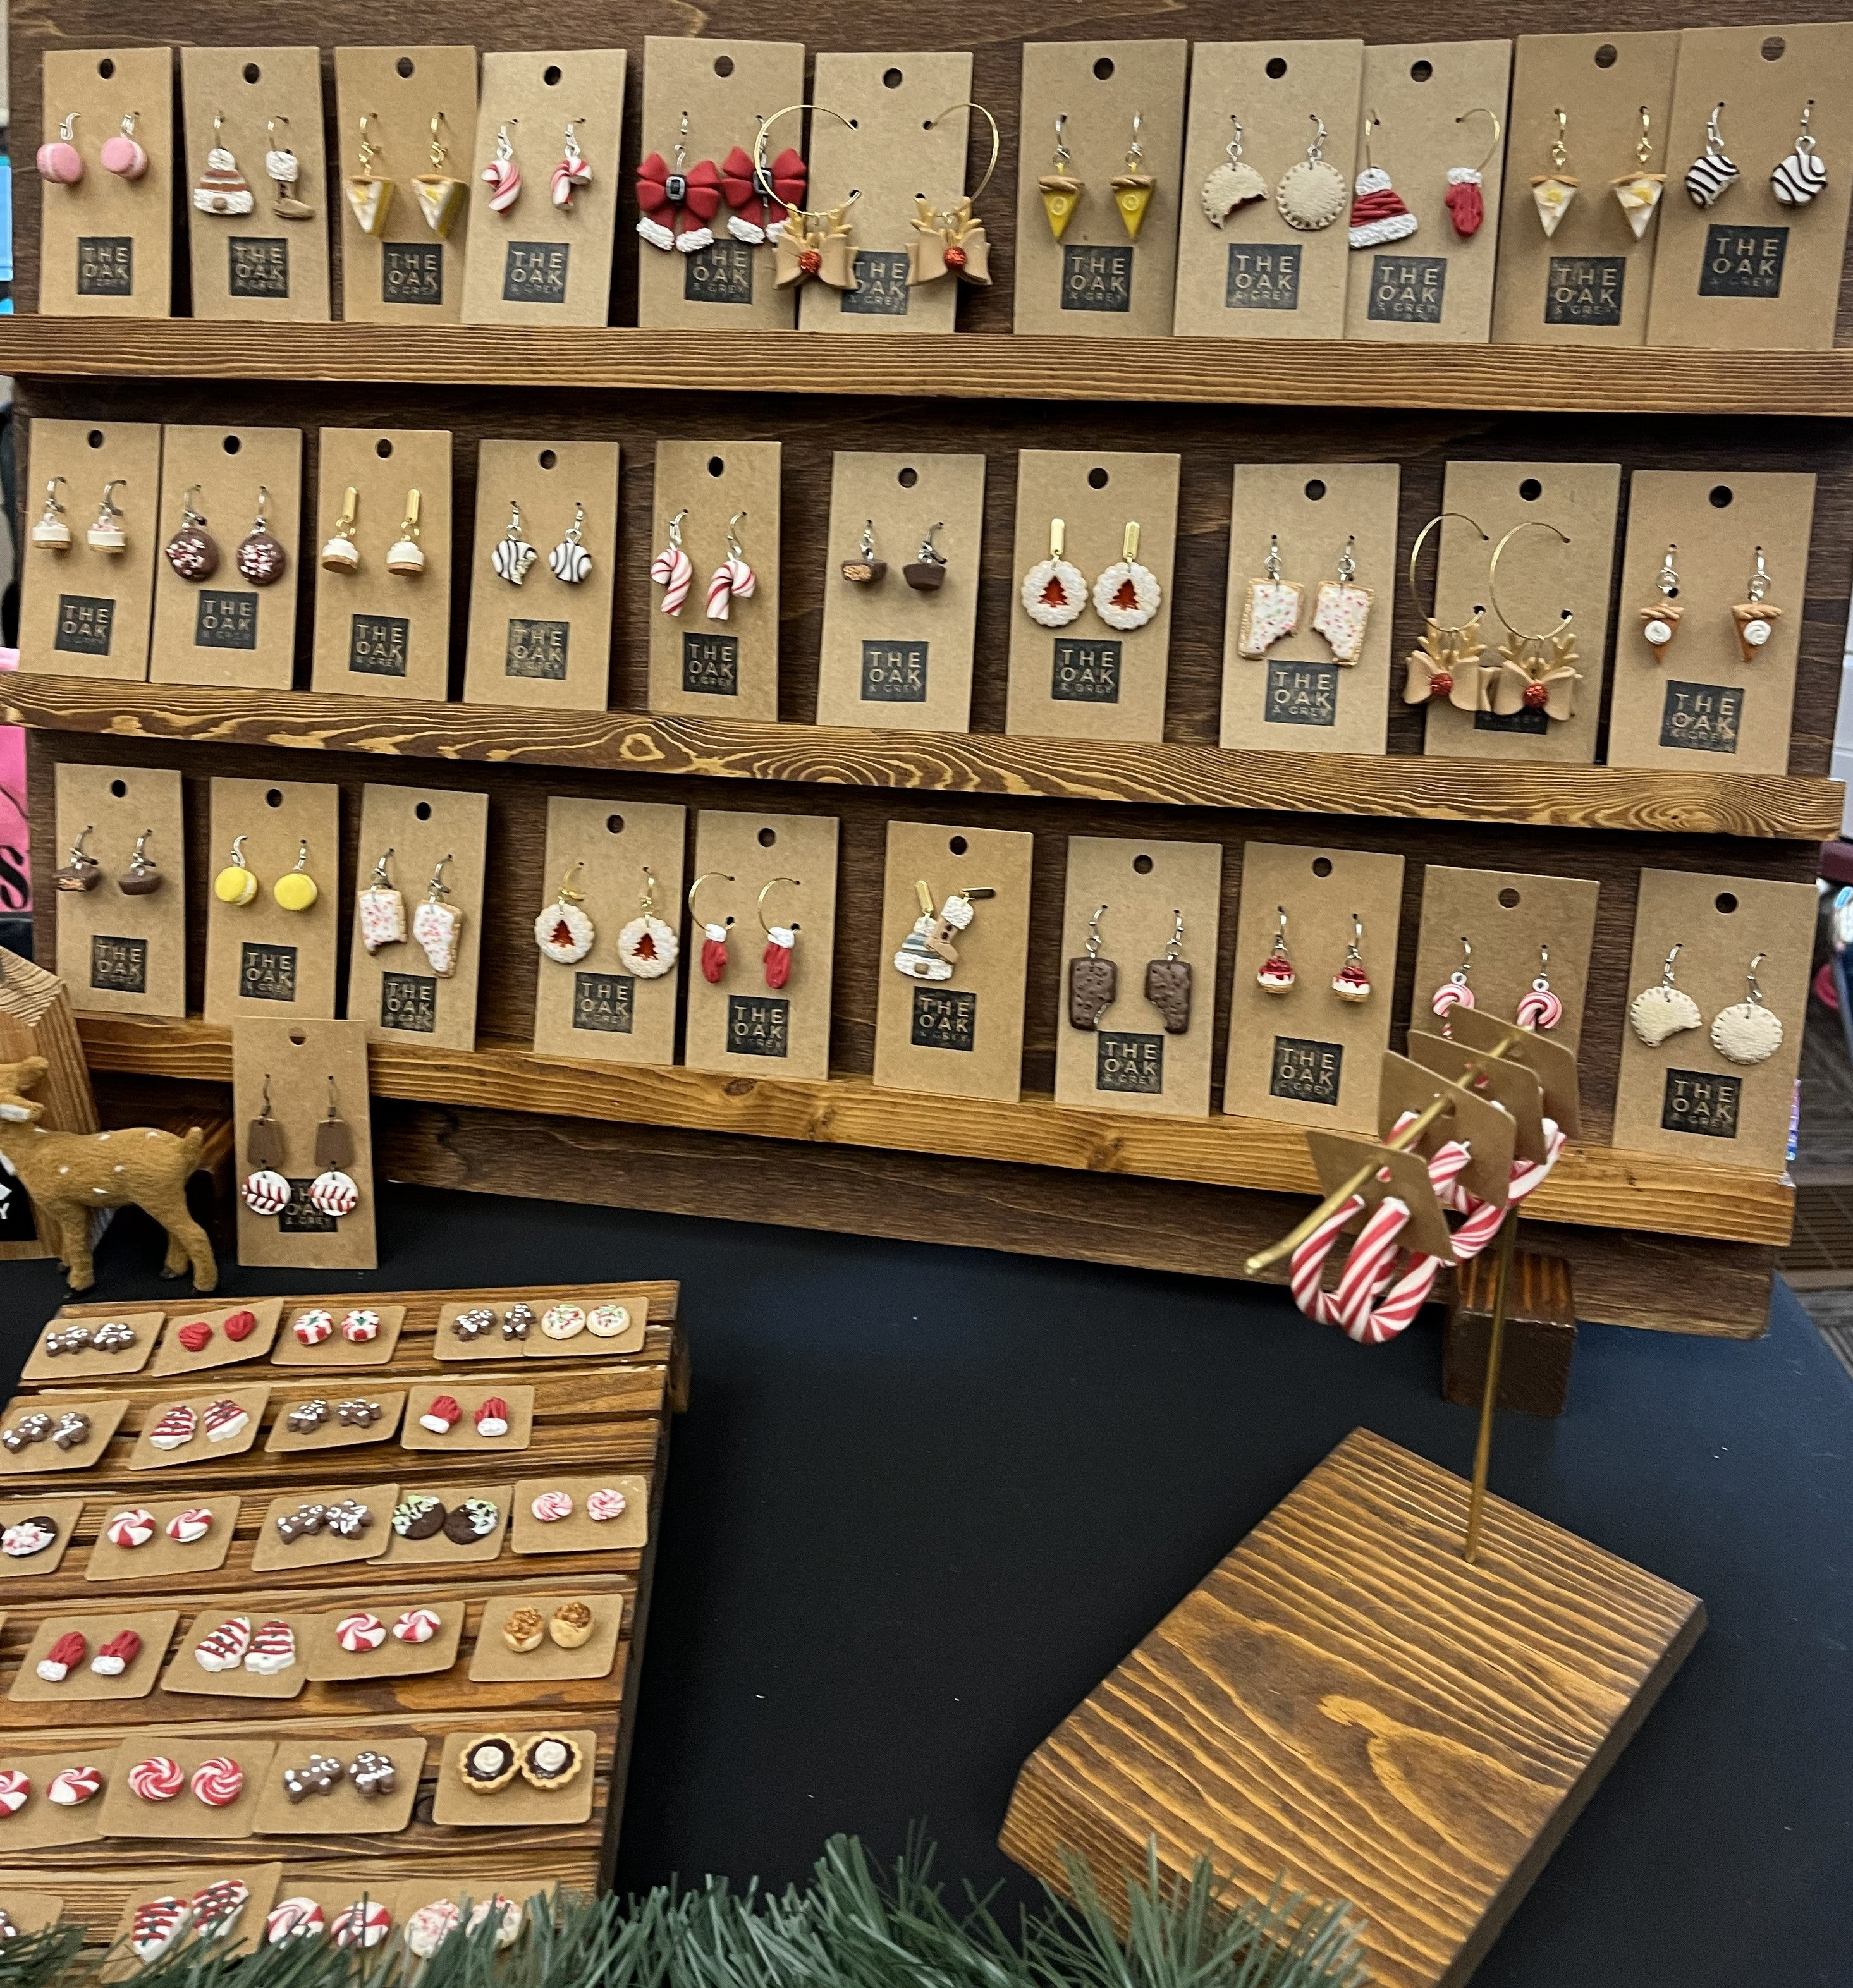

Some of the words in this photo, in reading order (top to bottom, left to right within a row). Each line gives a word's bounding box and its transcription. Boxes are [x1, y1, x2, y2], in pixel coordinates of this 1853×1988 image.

[82, 247, 128, 262] THE
[233, 246, 284, 264] THE
[1716, 238, 1778, 257] THE
[388, 253, 437, 271] THE
[511, 250, 563, 268] THE
[1071, 257, 1125, 274] THE
[1235, 254, 1293, 272] THE
[1713, 258, 1775, 276] OAK
[82, 264, 129, 278] OAK
[236, 264, 286, 279] OAK
[389, 271, 438, 289] OAK
[511, 269, 563, 285] OAK
[693, 266, 747, 286] OAK
[1381, 266, 1439, 286] THE
[1556, 268, 1618, 286] THE
[1071, 275, 1125, 292] OAK
[1235, 273, 1292, 290] OAK
[1378, 285, 1437, 303] OAK
[1555, 288, 1617, 307] OAK
[64, 605, 108, 624] THE
[204, 600, 251, 616] THE
[63, 621, 107, 638] OAK
[202, 616, 250, 631] OAK
[357, 625, 403, 643] THE
[514, 629, 563, 647] THE
[357, 641, 403, 659] OAK
[513, 645, 562, 662] OAK
[688, 643, 733, 662] THE
[1061, 649, 1114, 668] THE
[870, 651, 921, 668] THE
[689, 661, 733, 679] OAK
[869, 669, 921, 686] OAK
[1061, 667, 1115, 685] OAK
[1275, 671, 1331, 690] THE
[1274, 689, 1331, 708] OAK
[1675, 693, 1735, 715] THE
[1672, 712, 1734, 735] OAK
[97, 944, 142, 962] THE
[247, 952, 291, 970] THE
[97, 960, 142, 975] OAK
[246, 968, 292, 985] OAK
[388, 982, 431, 1001] THE
[582, 982, 628, 1001] THE
[388, 998, 431, 1016] OAK
[581, 999, 628, 1016] OAK
[735, 1006, 783, 1024] THE
[920, 997, 970, 1017] THE
[735, 1022, 783, 1039] OAK
[919, 1014, 969, 1033] OAK
[1105, 1041, 1158, 1059] THE
[1278, 1047, 1335, 1069] THE
[1104, 1058, 1156, 1076] OAK
[1279, 1064, 1334, 1087] OAK
[1675, 1080, 1734, 1103] THE
[1673, 1097, 1734, 1119] OAK
